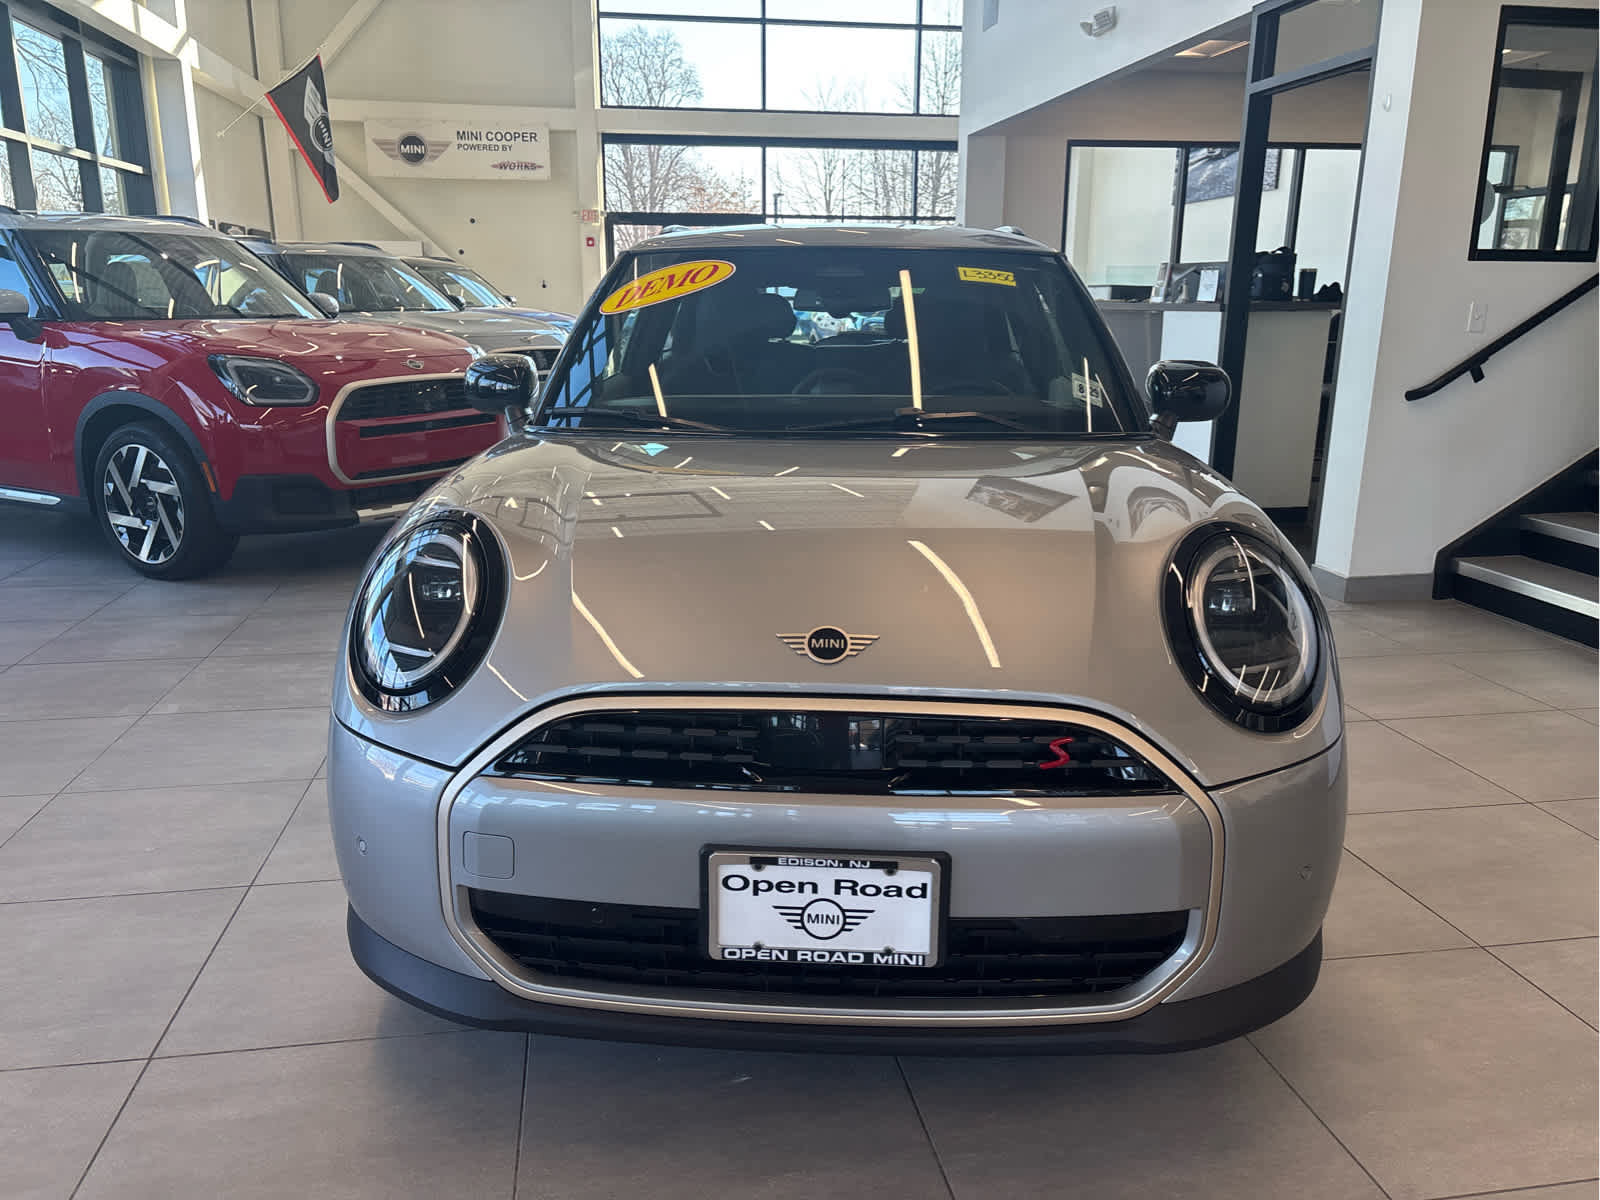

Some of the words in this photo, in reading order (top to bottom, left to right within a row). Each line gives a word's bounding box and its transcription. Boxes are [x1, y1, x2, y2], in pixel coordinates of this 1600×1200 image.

[456, 130, 482, 141] MINI
[485, 131, 538, 142] COOPER
[400, 144, 425, 154] MINI
[457, 143, 500, 152] POWERED
[501, 144, 513, 152] BY
[499, 161, 537, 171] WORKS
[614, 264, 719, 309] DEMO
[811, 638, 844, 648] MINI
[1039, 736, 1073, 770] S
[850, 859, 870, 868] NJ
[721, 874, 818, 896] Open
[833, 879, 928, 899] Road
[806, 913, 840, 925] MINI
[724, 948, 788, 961] OPEN
[797, 950, 864, 964] ROAD
[873, 953, 924, 966] MINI
